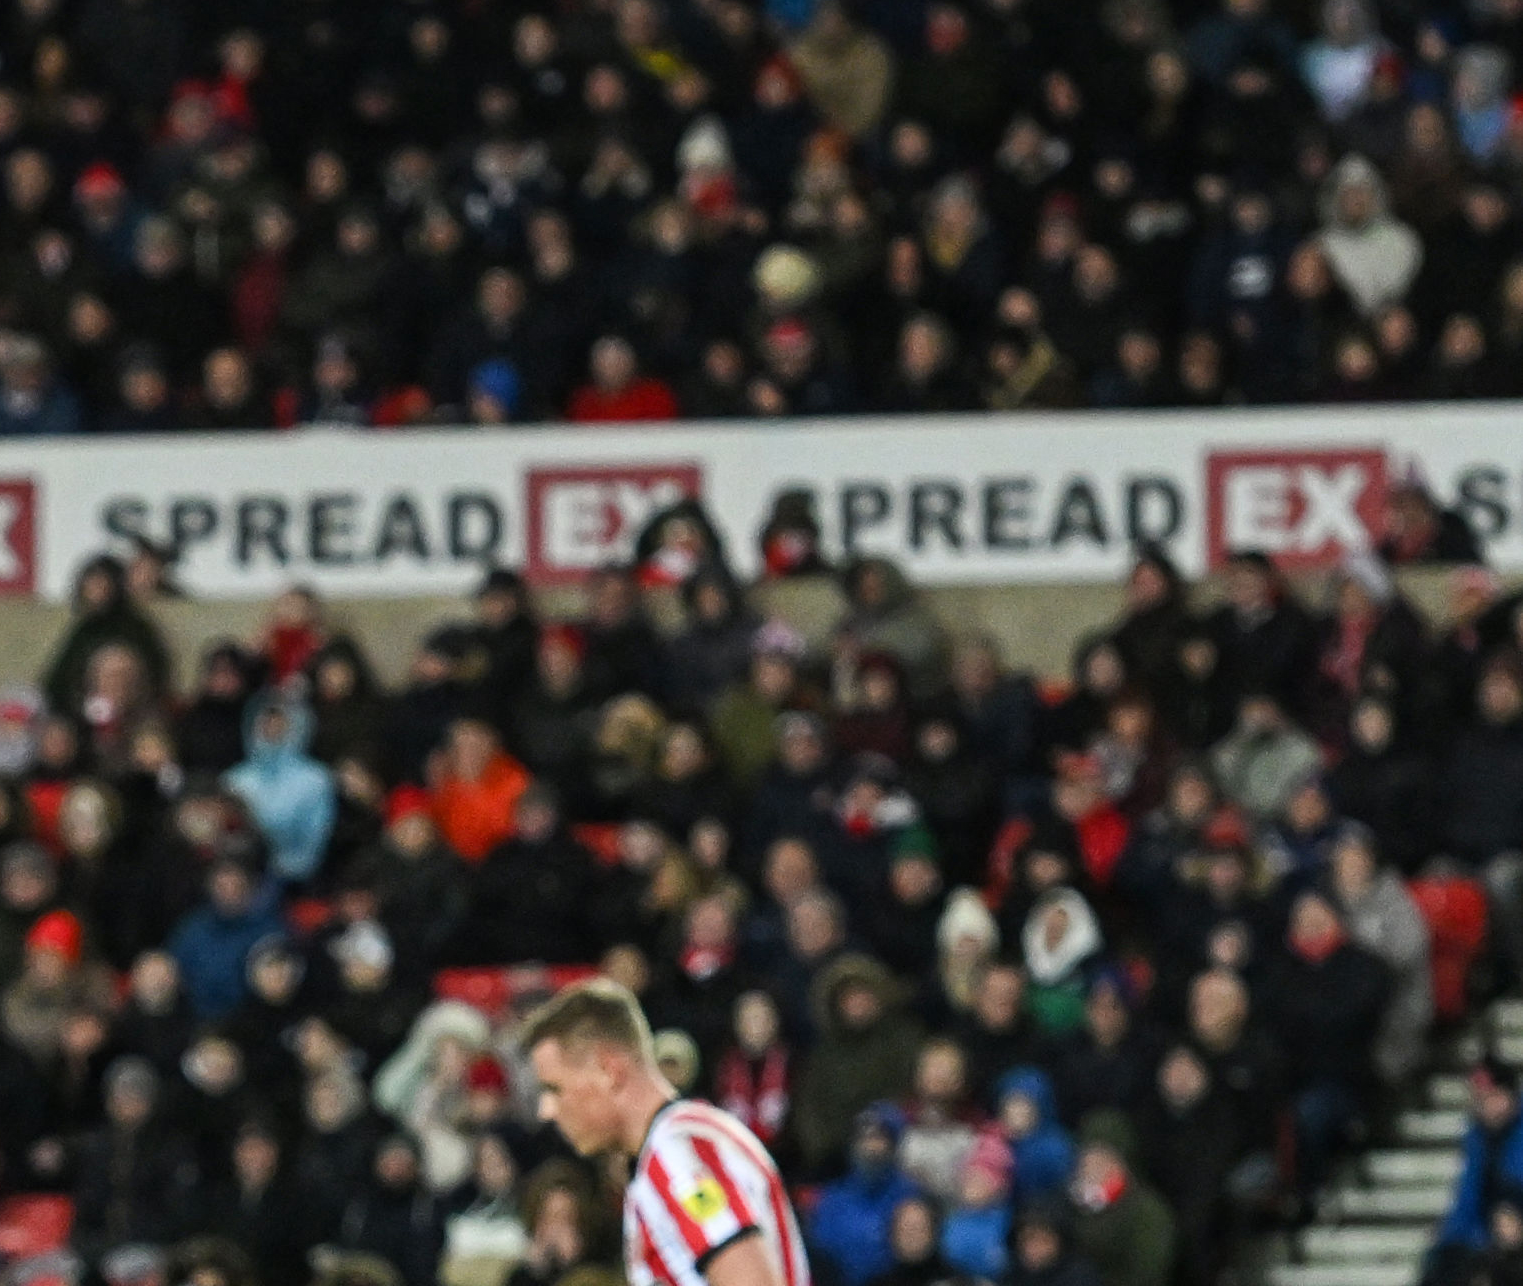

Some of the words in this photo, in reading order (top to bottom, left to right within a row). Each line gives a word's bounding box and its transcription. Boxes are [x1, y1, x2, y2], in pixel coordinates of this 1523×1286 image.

[102, 492, 504, 566] SPREAD
[839, 474, 1184, 552] PREAD
[1224, 466, 1371, 552] EX
